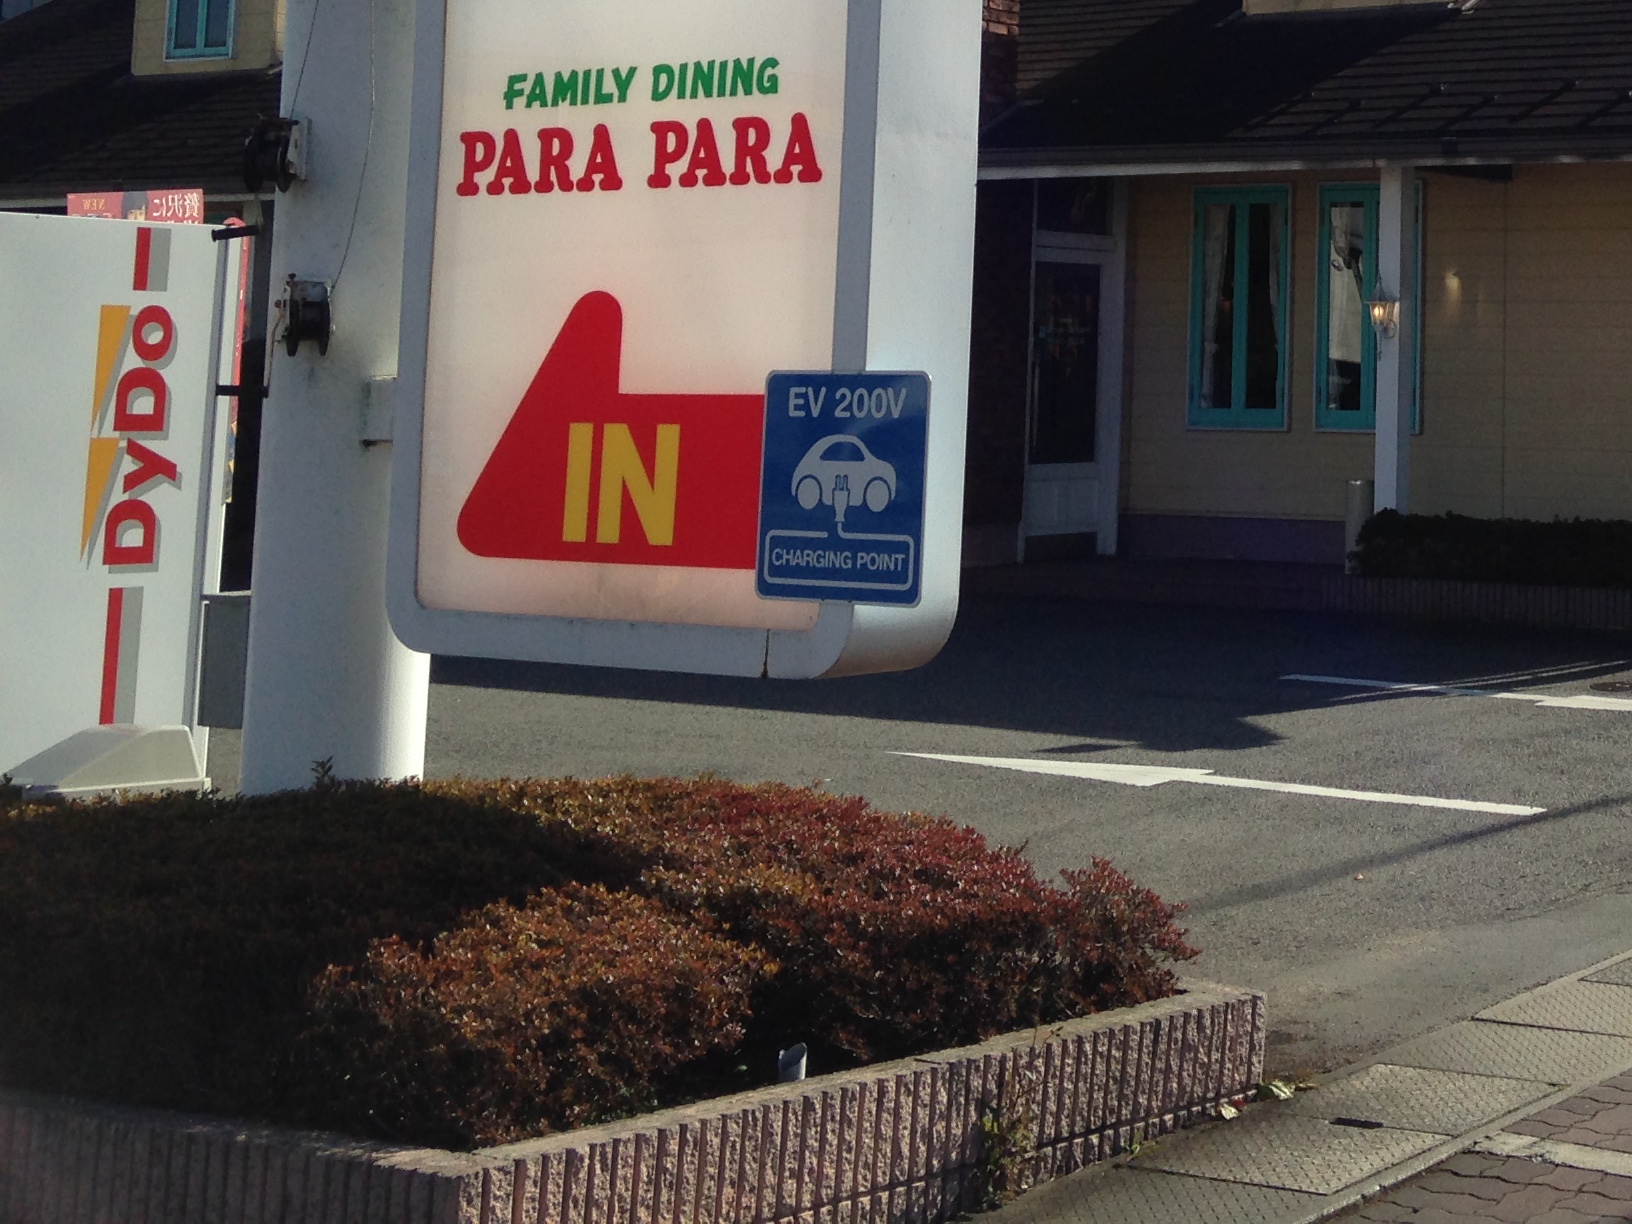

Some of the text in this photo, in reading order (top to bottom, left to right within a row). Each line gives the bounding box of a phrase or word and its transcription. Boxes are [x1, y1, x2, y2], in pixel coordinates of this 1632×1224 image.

[503, 56, 779, 110] FAMILY DINING
[456, 112, 823, 197] PARA PARA
[102, 305, 178, 566] DyDo
[788, 387, 908, 419] EV 200V
[562, 422, 680, 546] IN
[772, 548, 906, 572] CHARGING POINT
